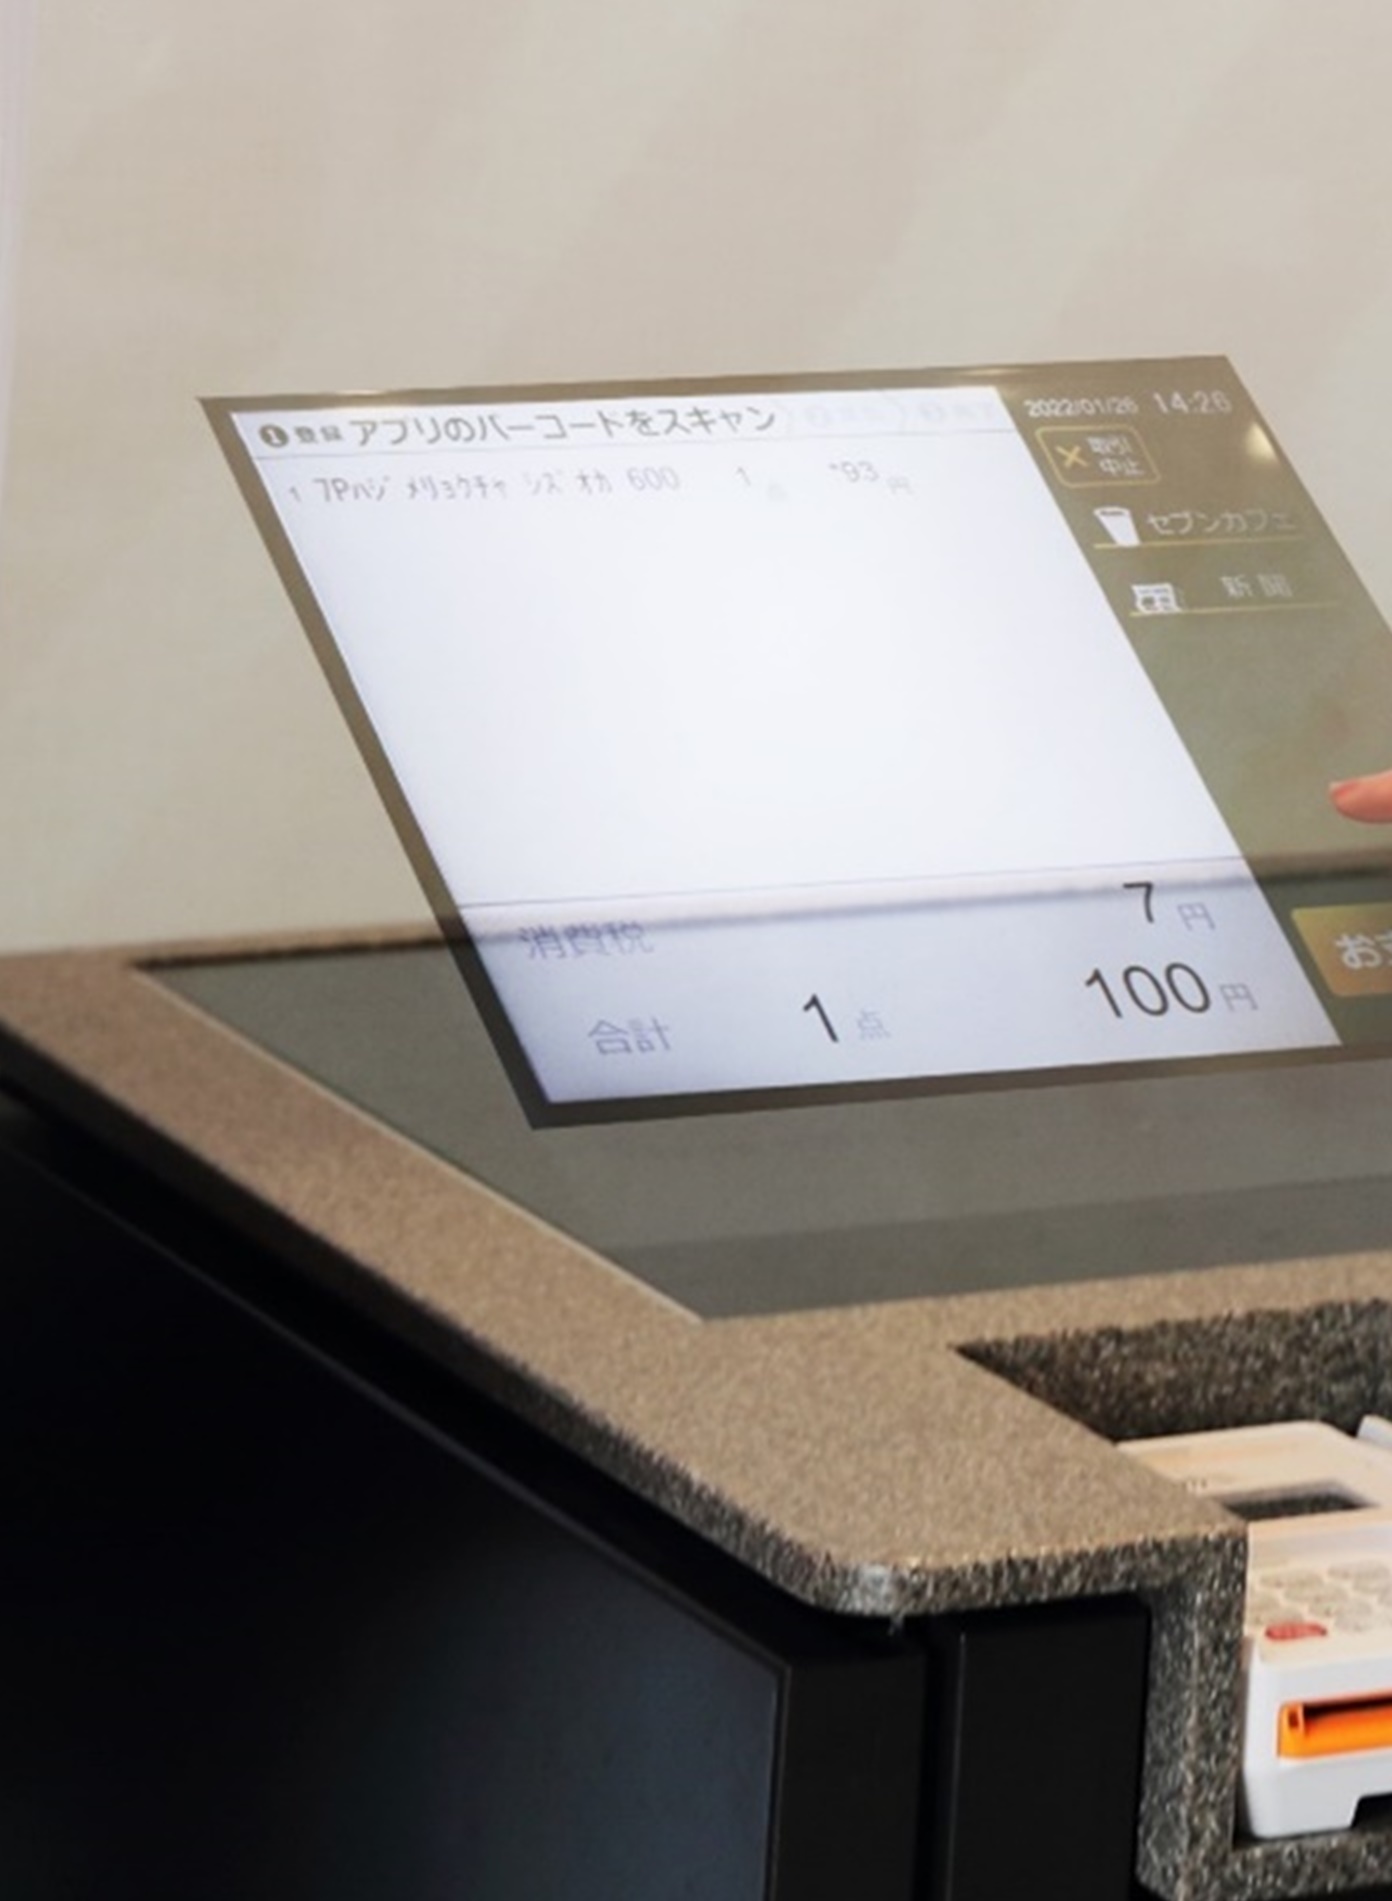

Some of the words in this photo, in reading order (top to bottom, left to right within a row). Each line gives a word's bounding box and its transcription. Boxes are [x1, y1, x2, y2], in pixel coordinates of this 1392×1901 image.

[1152, 389, 1233, 415] 14:26
[1148, 508, 1297, 536] セブンカフェ
[519, 920, 655, 960] 消費税
[1123, 881, 1155, 924] 7
[1178, 902, 1217, 931] 円
[587, 1016, 673, 1056] 合計
[803, 993, 839, 1044] 1
[855, 1008, 892, 1042] 点
[1084, 961, 1212, 1019] 100
[1218, 981, 1259, 1013] 円
